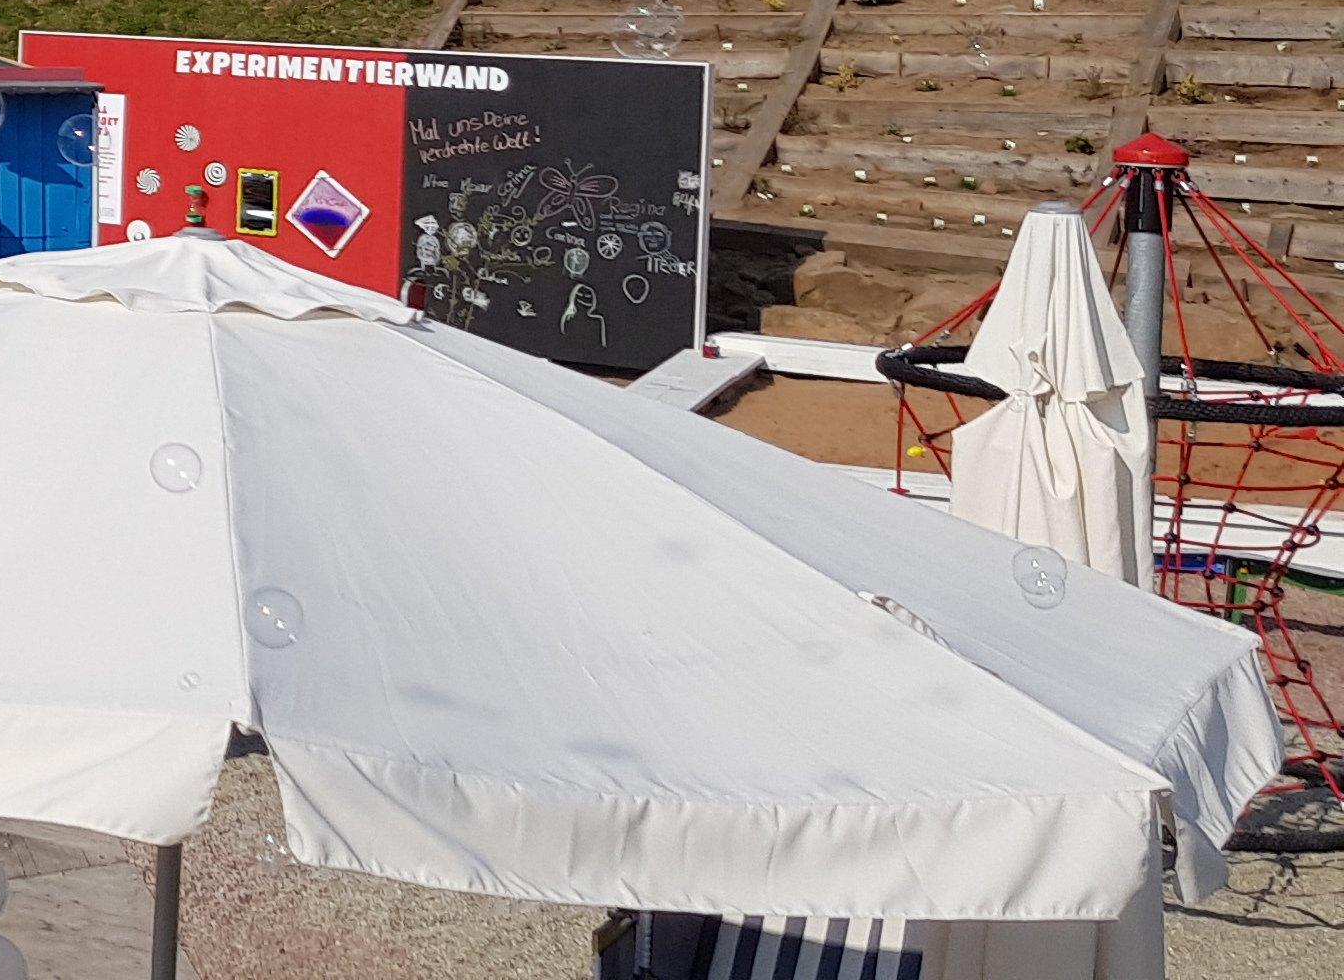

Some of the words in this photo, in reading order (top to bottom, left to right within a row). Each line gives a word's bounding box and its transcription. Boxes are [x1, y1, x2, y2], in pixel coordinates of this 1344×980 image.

[175, 49, 509, 91] EXPERIMENTIERWAND
[408, 117, 440, 145] Mal
[448, 117, 483, 138] uns
[483, 111, 529, 128] Deine
